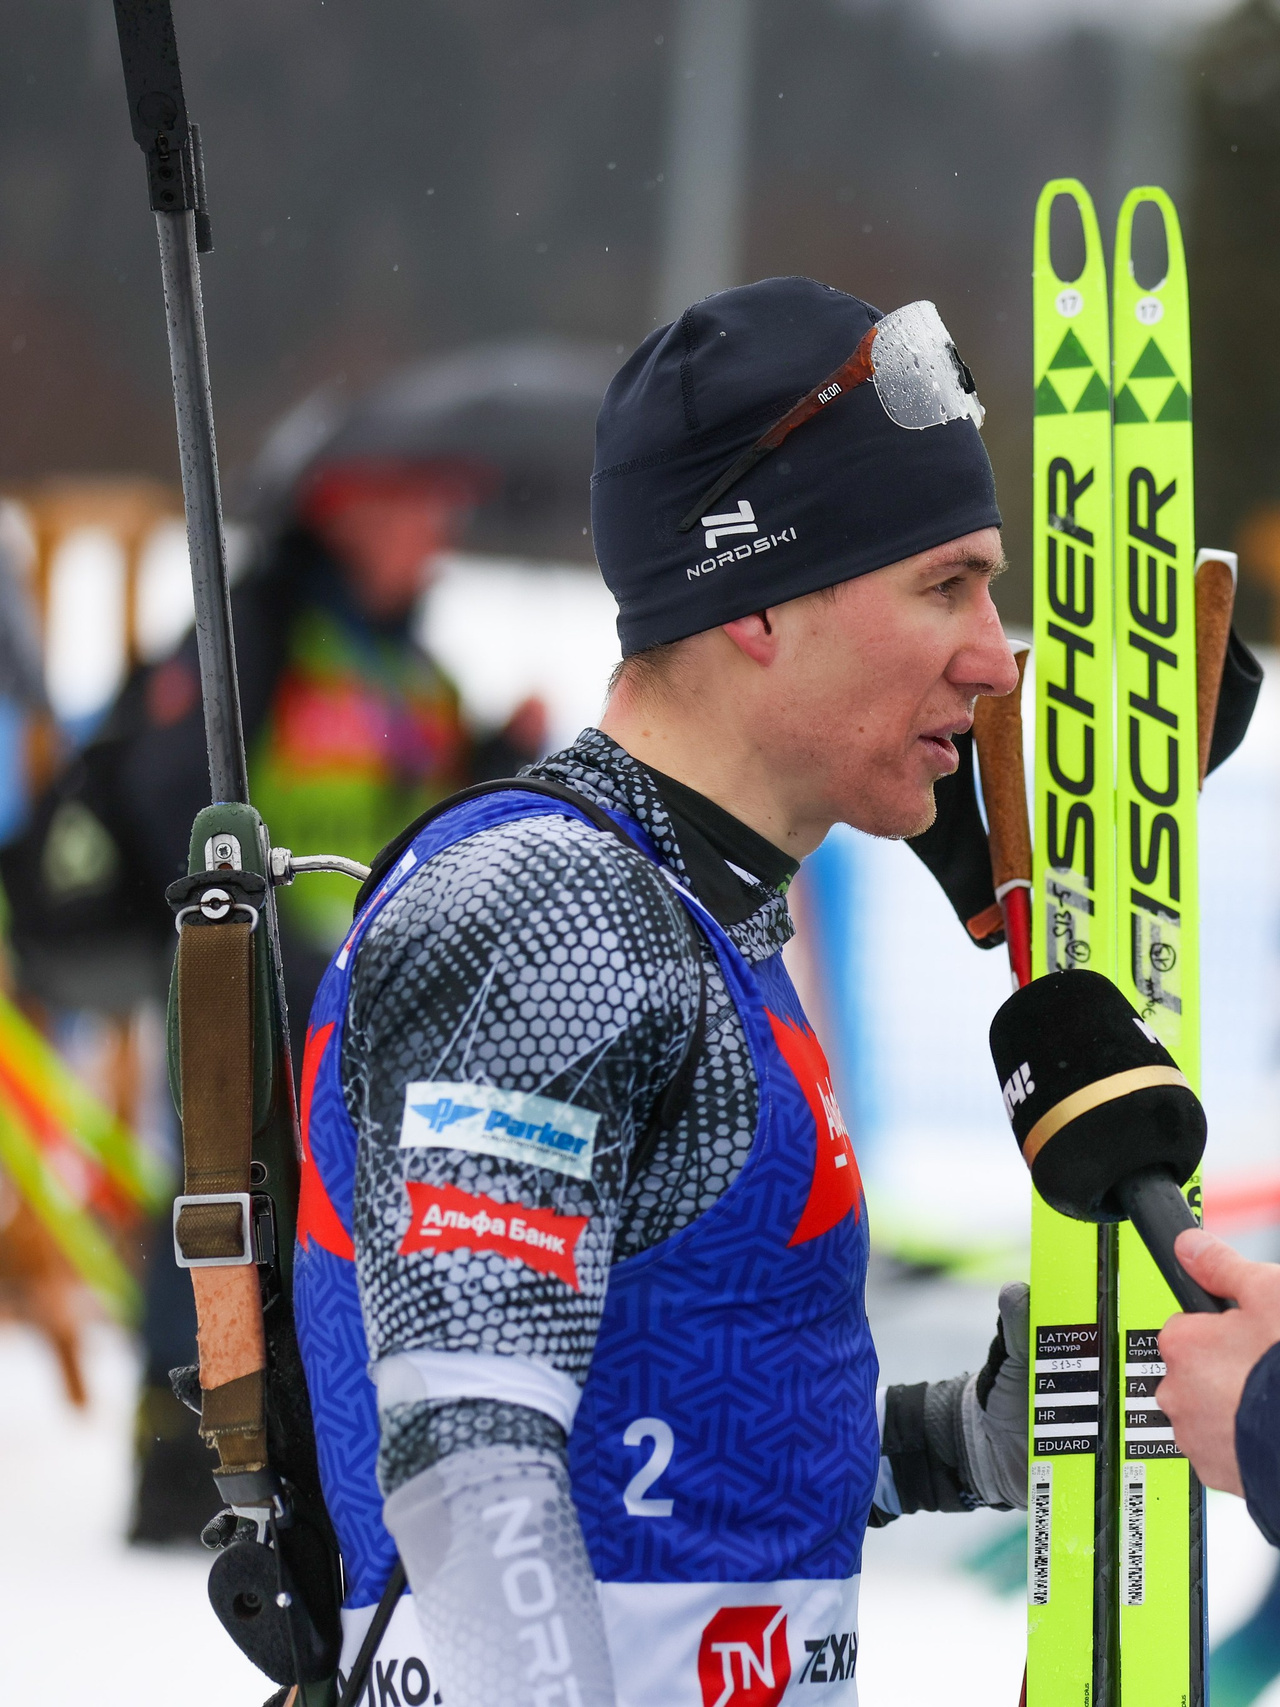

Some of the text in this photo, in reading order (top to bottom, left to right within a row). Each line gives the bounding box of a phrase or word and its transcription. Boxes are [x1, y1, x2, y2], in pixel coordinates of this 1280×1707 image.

[1061, 295, 1077, 312] 17
[1141, 303, 1158, 319] 17
[817, 383, 842, 405] NEON
[686, 526, 798, 581] NORDSKI
[1129, 466, 1182, 1015] FISCHER
[484, 1109, 589, 1154] Parker
[421, 1203, 567, 1255] Альфа Банк
[1038, 1331, 1098, 1344] LATYPOV
[1129, 1336, 1159, 1347] LATY
[1038, 1344, 1081, 1353] структура
[1128, 1348, 1161, 1357] структу
[1140, 1363, 1168, 1374] S13-
[1039, 1379, 1056, 1389] FA
[1129, 1382, 1147, 1393] FA
[1038, 1410, 1056, 1421] HR
[1129, 1413, 1147, 1424] HR
[1037, 1439, 1090, 1452] EDUARD
[622, 1417, 675, 1517] 2
